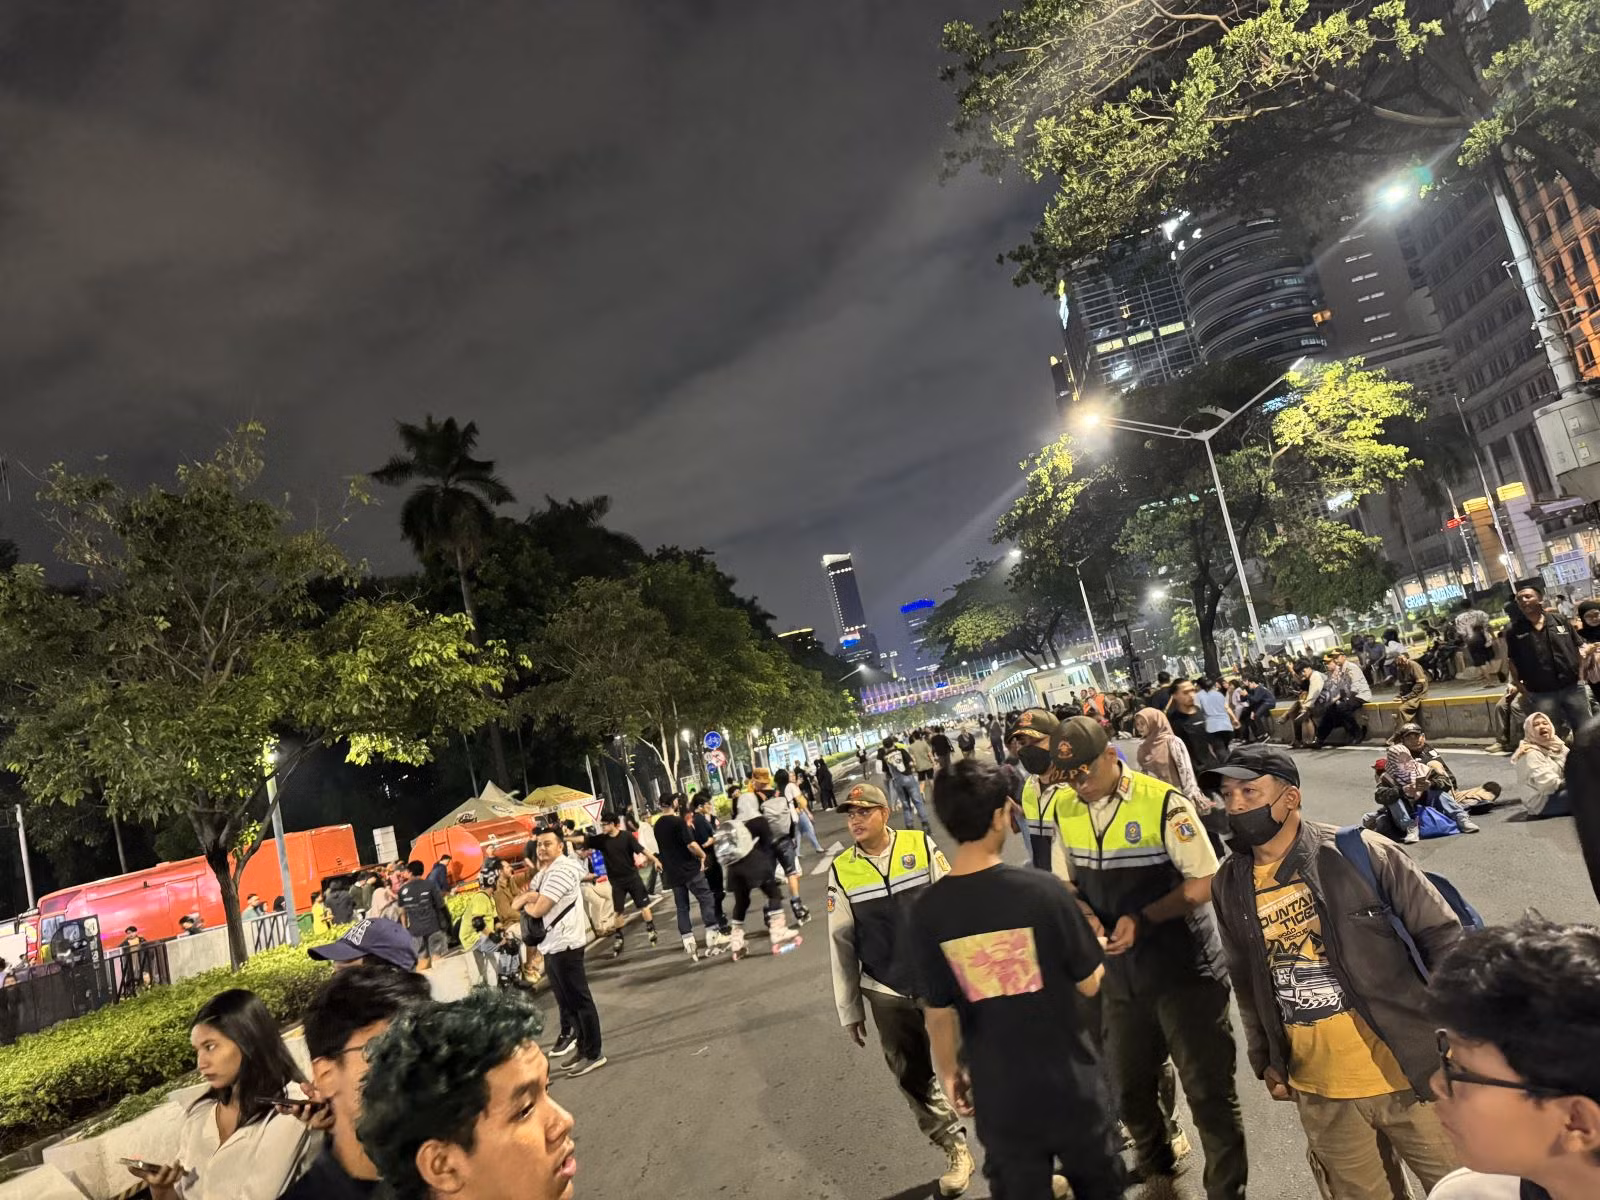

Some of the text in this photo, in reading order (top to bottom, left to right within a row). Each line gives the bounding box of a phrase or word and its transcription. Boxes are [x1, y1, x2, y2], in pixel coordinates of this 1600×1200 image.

[1259, 894, 1313, 929] OUNTAI
[1279, 905, 1315, 930] TIGE
[1284, 928, 1308, 942] RESCUE
